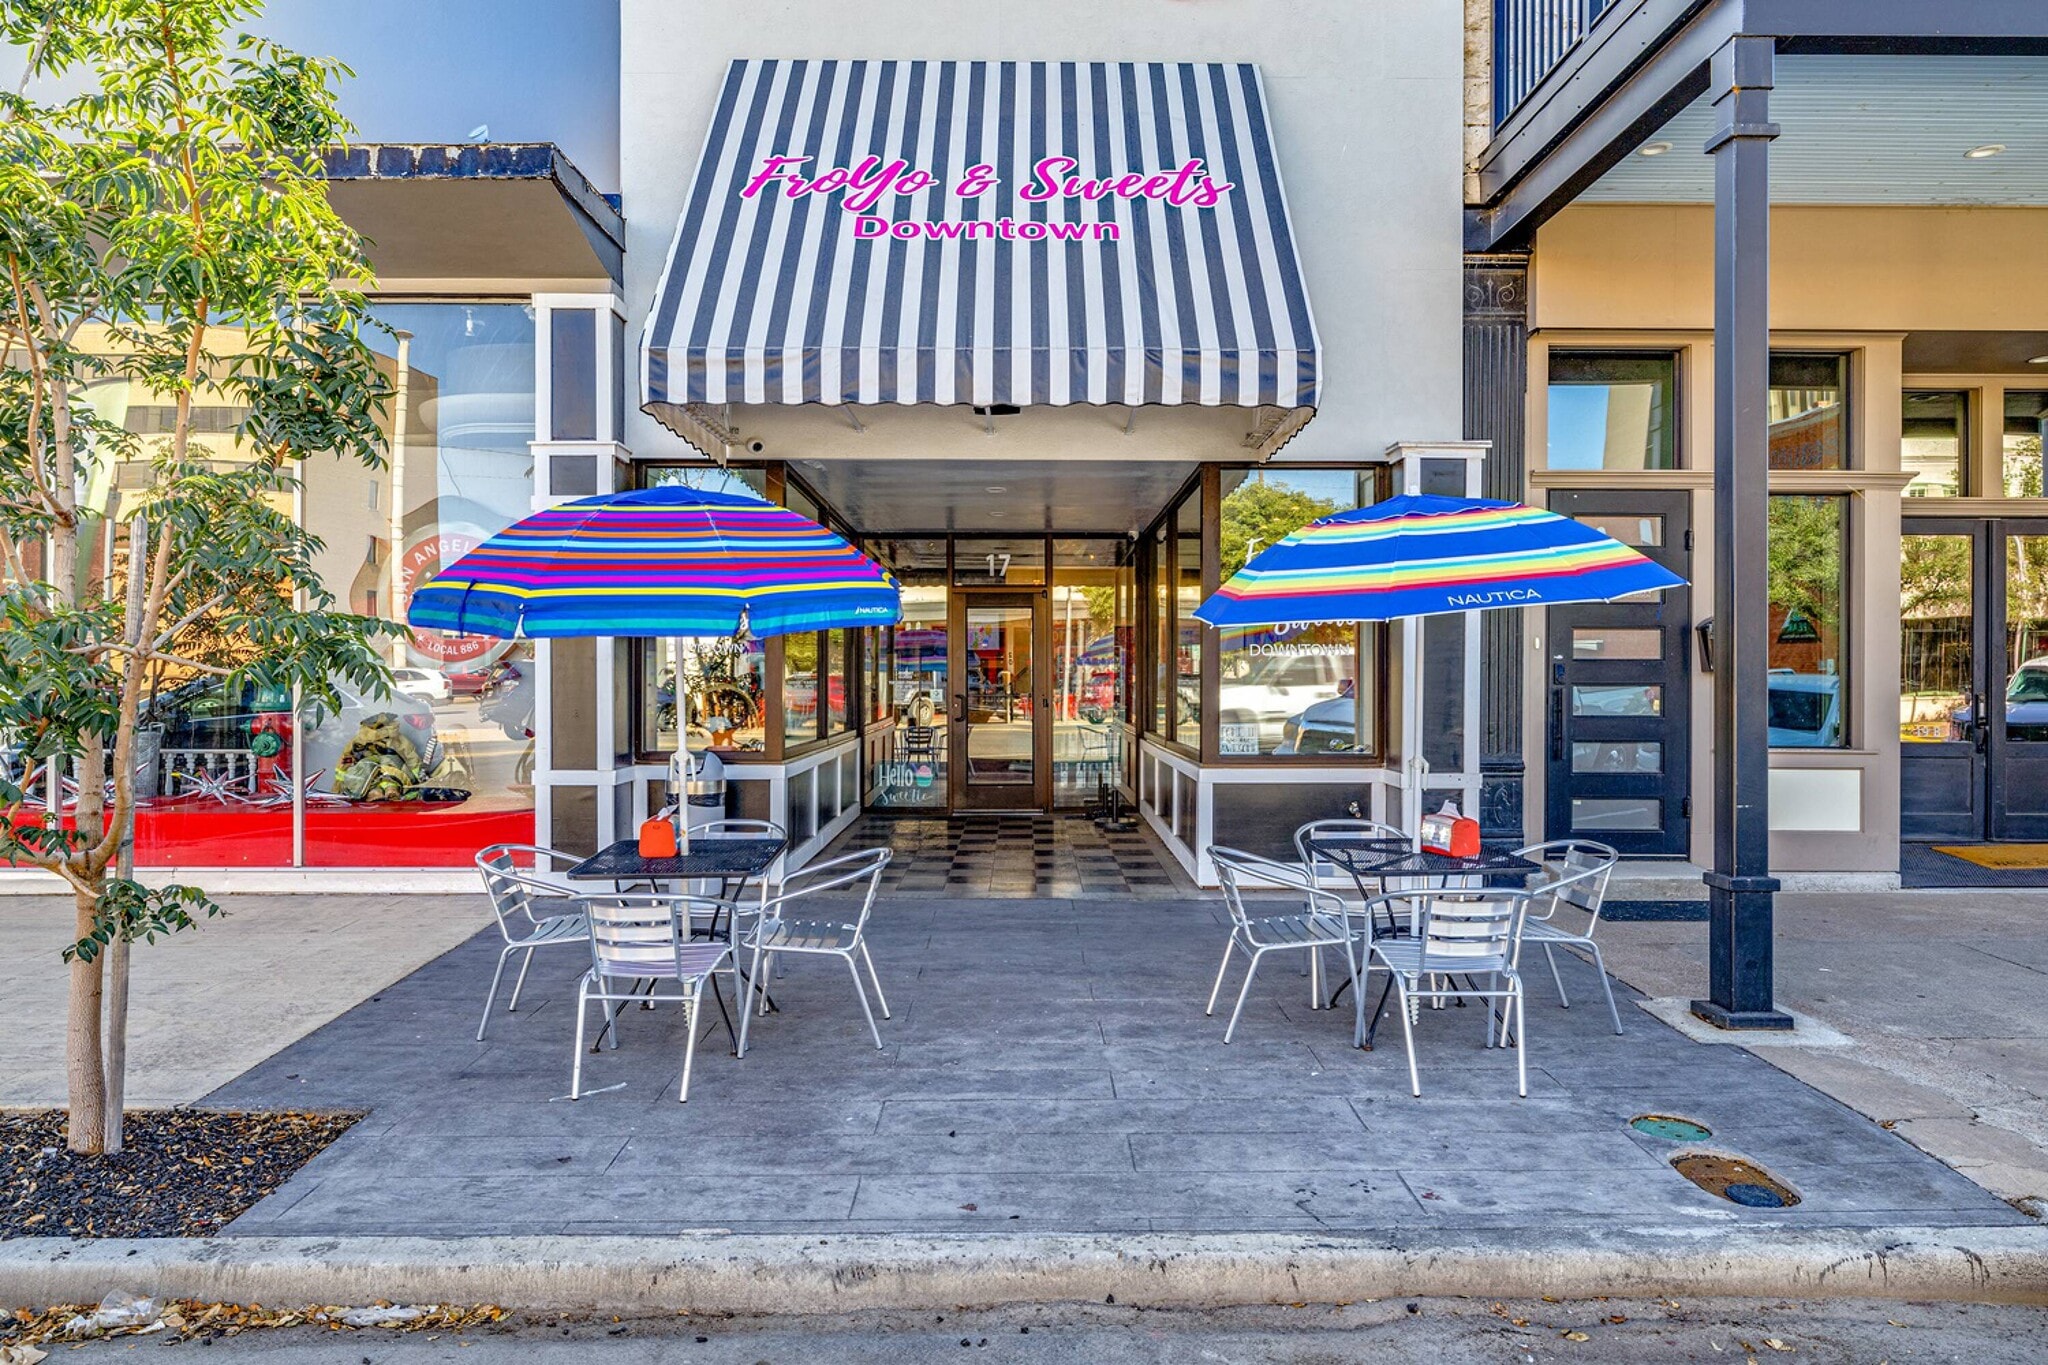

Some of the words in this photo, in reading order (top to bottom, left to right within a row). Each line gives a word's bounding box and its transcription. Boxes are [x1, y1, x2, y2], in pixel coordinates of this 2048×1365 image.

[741, 156, 935, 211] FroYo
[956, 164, 999, 198] &
[1019, 156, 1234, 208] Sweets
[852, 216, 1120, 240] Downtown
[986, 553, 1011, 577] 17
[1447, 588, 1543, 607] NAUTICA
[858, 606, 889, 614] NAUTICA
[427, 641, 459, 656] LOCAL
[460, 640, 480, 655] 886
[1248, 643, 1351, 657] DOWNTOWN
[878, 763, 914, 787] Hello
